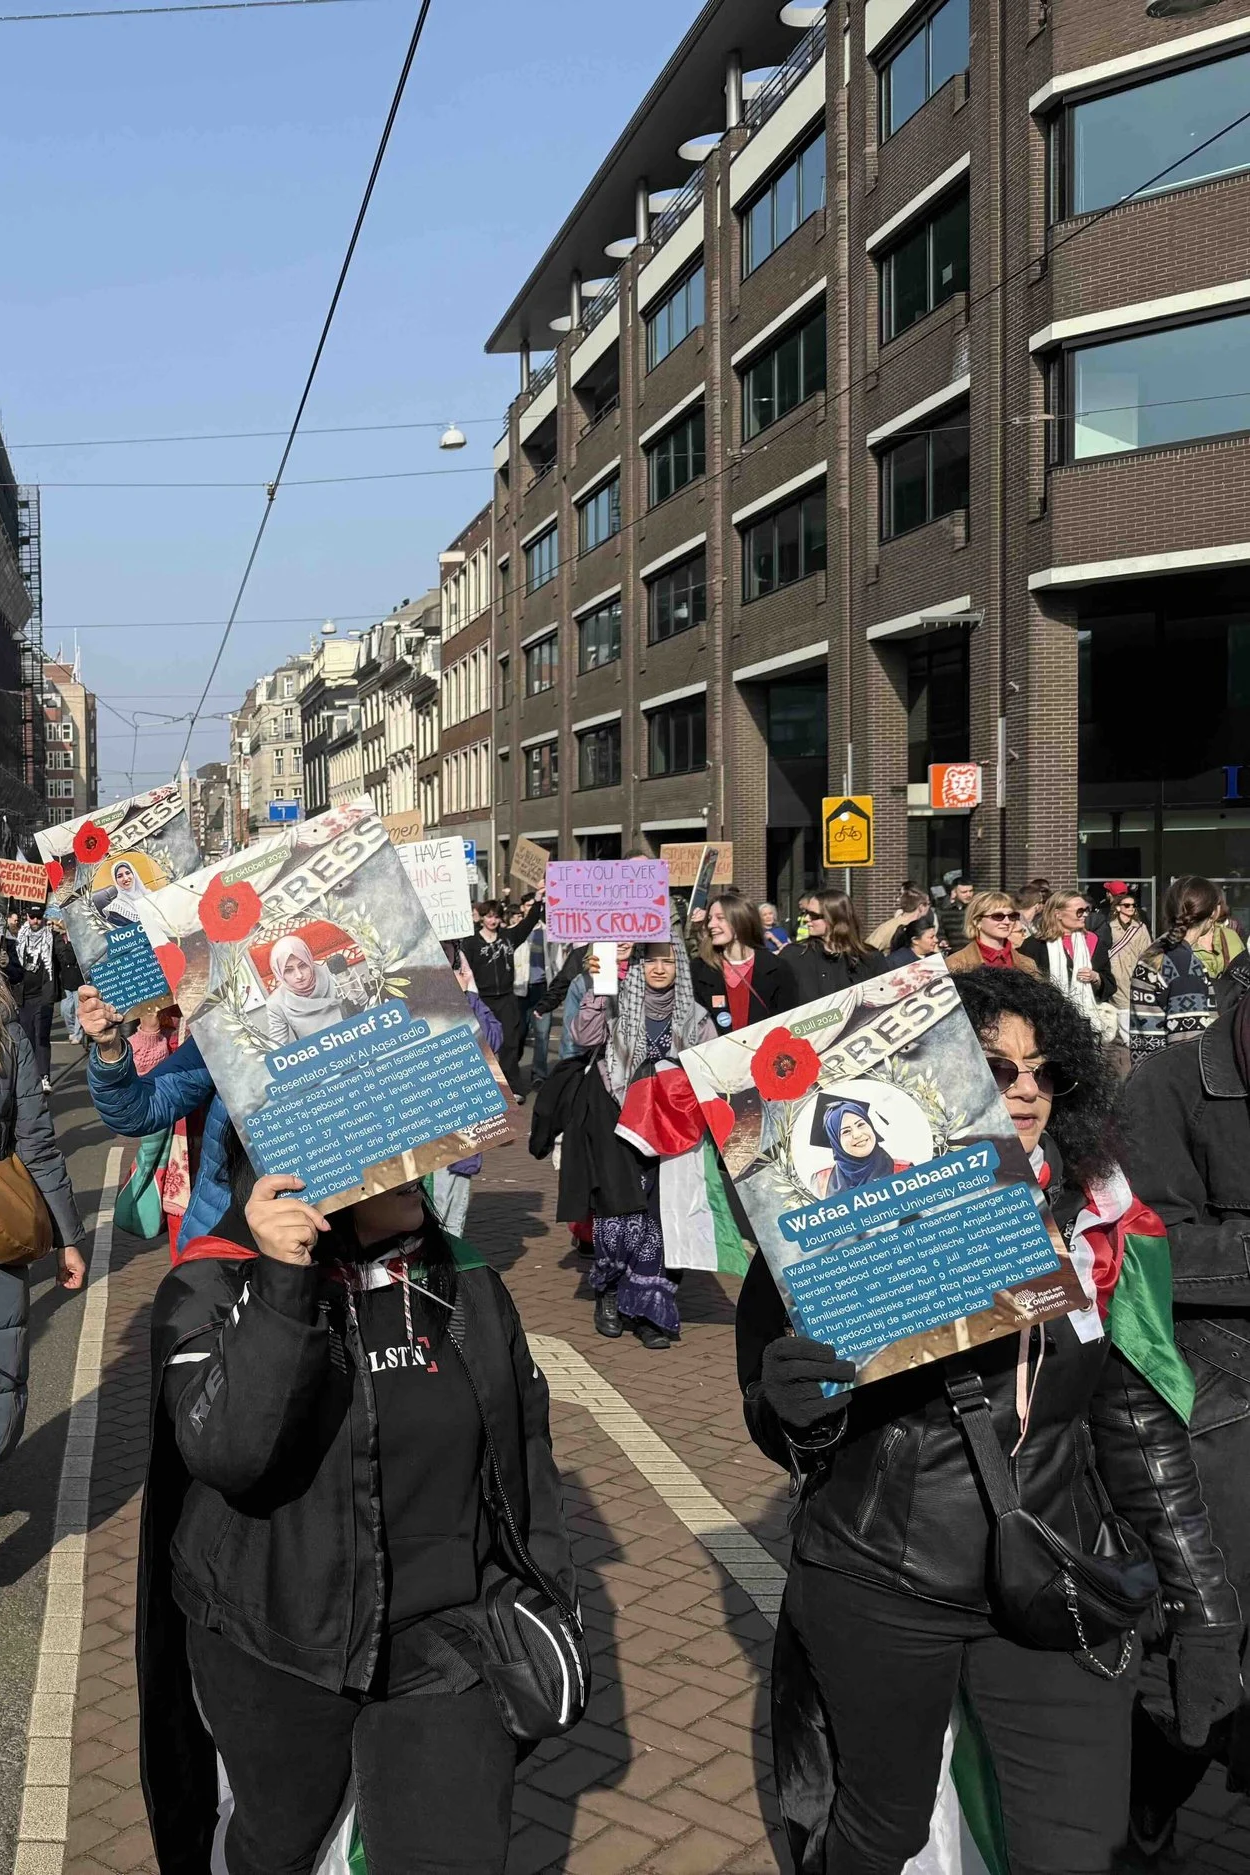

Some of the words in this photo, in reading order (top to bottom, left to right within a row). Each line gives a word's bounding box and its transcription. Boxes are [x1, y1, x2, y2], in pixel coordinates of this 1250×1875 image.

[110, 790, 183, 850] PRESS
[387, 823, 419, 839] men
[224, 873, 234, 884] 27
[235, 859, 267, 878] oktober
[268, 850, 289, 864] 2023
[262, 815, 384, 916] PRESS
[415, 841, 452, 863] HAVE
[558, 866, 573, 881] IF
[585, 865, 613, 880] YOU
[621, 865, 656, 880] EVER
[411, 865, 451, 888] HING
[565, 884, 599, 898] FEEL
[110, 929, 135, 943] Noor
[554, 912, 592, 933] THIS
[596, 912, 662, 934] CROWD
[273, 1045, 319, 1072] Doaa
[320, 1016, 377, 1051] Sharaf
[379, 1009, 402, 1029] 33
[794, 1026, 801, 1035] 6
[802, 1021, 816, 1034] juli
[818, 1014, 839, 1026] 2024
[821, 979, 955, 1074] PRESS
[246, 1117, 260, 1127] Op
[260, 1112, 273, 1122] 25
[273, 1098, 304, 1116] oktober
[305, 1089, 327, 1103] 2023
[326, 1074, 363, 1094] kwamen
[362, 1067, 376, 1078] bij
[375, 1059, 393, 1073] een
[393, 1042, 439, 1066] Israëlische
[440, 1028, 469, 1046] aanval
[270, 1062, 328, 1096] Presentator
[329, 1052, 355, 1071] Sawt
[358, 1047, 369, 1060] Al
[371, 1037, 397, 1057] Aqsa
[398, 1025, 425, 1043] radio
[252, 1129, 265, 1139] op
[266, 1121, 282, 1132] het
[285, 1095, 344, 1126] al-Taj-gebouw
[348, 1089, 360, 1099] en
[363, 1083, 376, 1092] de
[378, 1060, 430, 1086] omliggende
[433, 1041, 475, 1065] gebieden
[257, 1130, 295, 1151] minstens
[298, 1123, 313, 1134] 101
[315, 1108, 350, 1127] mensen
[353, 1100, 368, 1111] om
[369, 1091, 386, 1104] het
[388, 1081, 416, 1096] leven,
[418, 1059, 464, 1083] waaronder
[469, 1053, 481, 1063] 44
[481, 1126, 510, 1142] Hamdan
[786, 1203, 849, 1233] Wafaa
[853, 1189, 890, 1211] Abu
[892, 1160, 964, 1196] Dabaan
[967, 1151, 989, 1169] 27
[805, 1221, 857, 1248] Journalist
[860, 1207, 900, 1227] Islamic
[900, 1187, 955, 1212] University
[957, 1174, 990, 1192] Radio
[786, 1262, 817, 1277] Wafaa
[821, 1255, 839, 1266] Abu
[841, 1241, 877, 1258] Dabaan
[879, 1233, 899, 1244] was
[902, 1225, 915, 1236] vijf
[919, 1210, 962, 1230] maanden
[965, 1194, 1004, 1214] zwanger
[1008, 1187, 1026, 1198] van
[791, 1277, 812, 1290] haar
[813, 1265, 848, 1282] tweede
[848, 1256, 869, 1270] kind
[869, 1250, 891, 1262] toen
[891, 1244, 903, 1255] zij
[903, 1241, 916, 1250] en
[915, 1233, 936, 1245] haar
[938, 1225, 961, 1237] man,
[963, 1212, 992, 1229] Amjad
[994, 1199, 1031, 1218] Jahjouh,
[1038, 1299, 1068, 1313] Hamdan
[367, 1346, 427, 1373] LSTN
